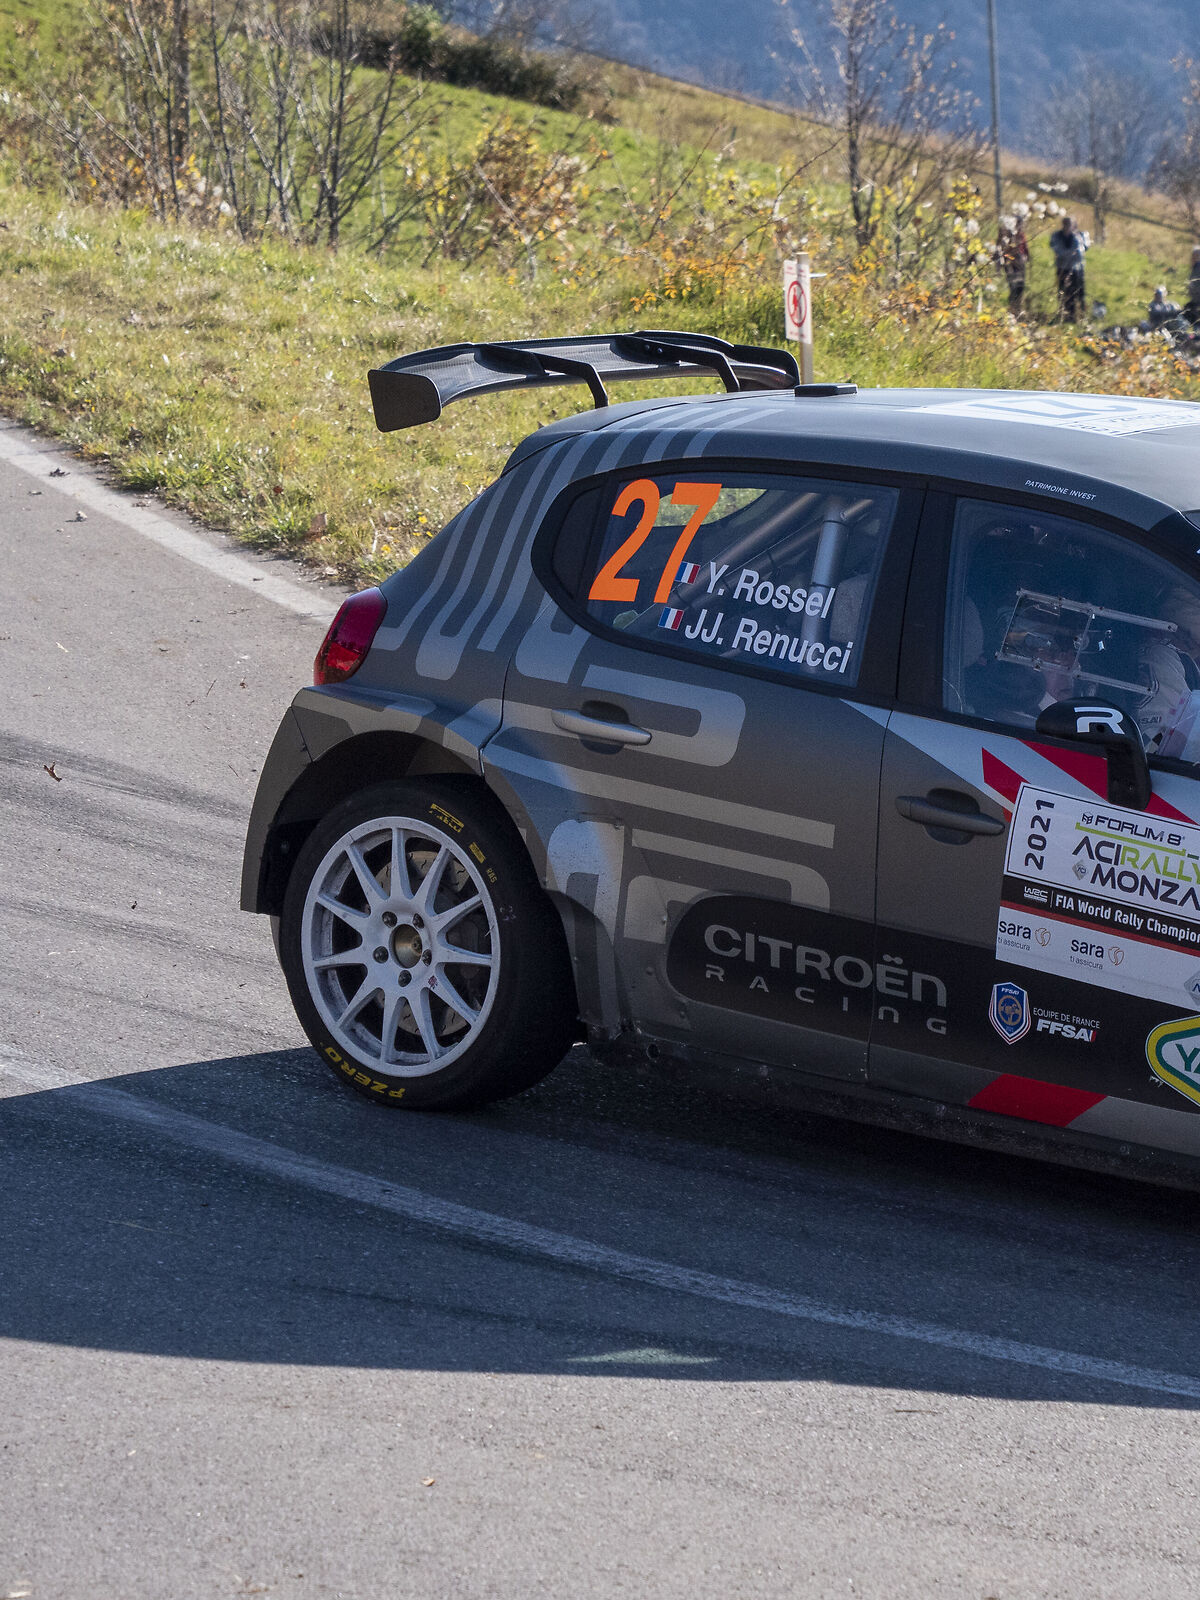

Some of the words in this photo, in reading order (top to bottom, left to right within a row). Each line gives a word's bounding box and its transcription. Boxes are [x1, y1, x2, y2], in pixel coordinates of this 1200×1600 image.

[1024, 479, 1068, 496] PATRIMOINE
[1069, 489, 1097, 501] INVEST
[588, 478, 723, 604] 27
[704, 561, 730, 596] Y.
[733, 568, 836, 619] Rossel
[684, 609, 724, 646] JJ.
[731, 617, 854, 674] Renucci
[1024, 799, 1056, 871] 2021
[1094, 814, 1164, 843] FORUM
[1166, 833, 1183, 847] 8
[1055, 894, 1075, 911] FIA
[1077, 899, 1112, 921] World
[1113, 909, 1144, 930] Rally
[998, 919, 1032, 941] sara
[1003, 938, 1031, 952] assicura
[1070, 938, 1105, 959] sara
[1075, 957, 1104, 971] assicura
[1033, 1007, 1060, 1020] EQUIPE
[1060, 1013, 1071, 1022] DE
[1072, 1016, 1101, 1029] FRANCE
